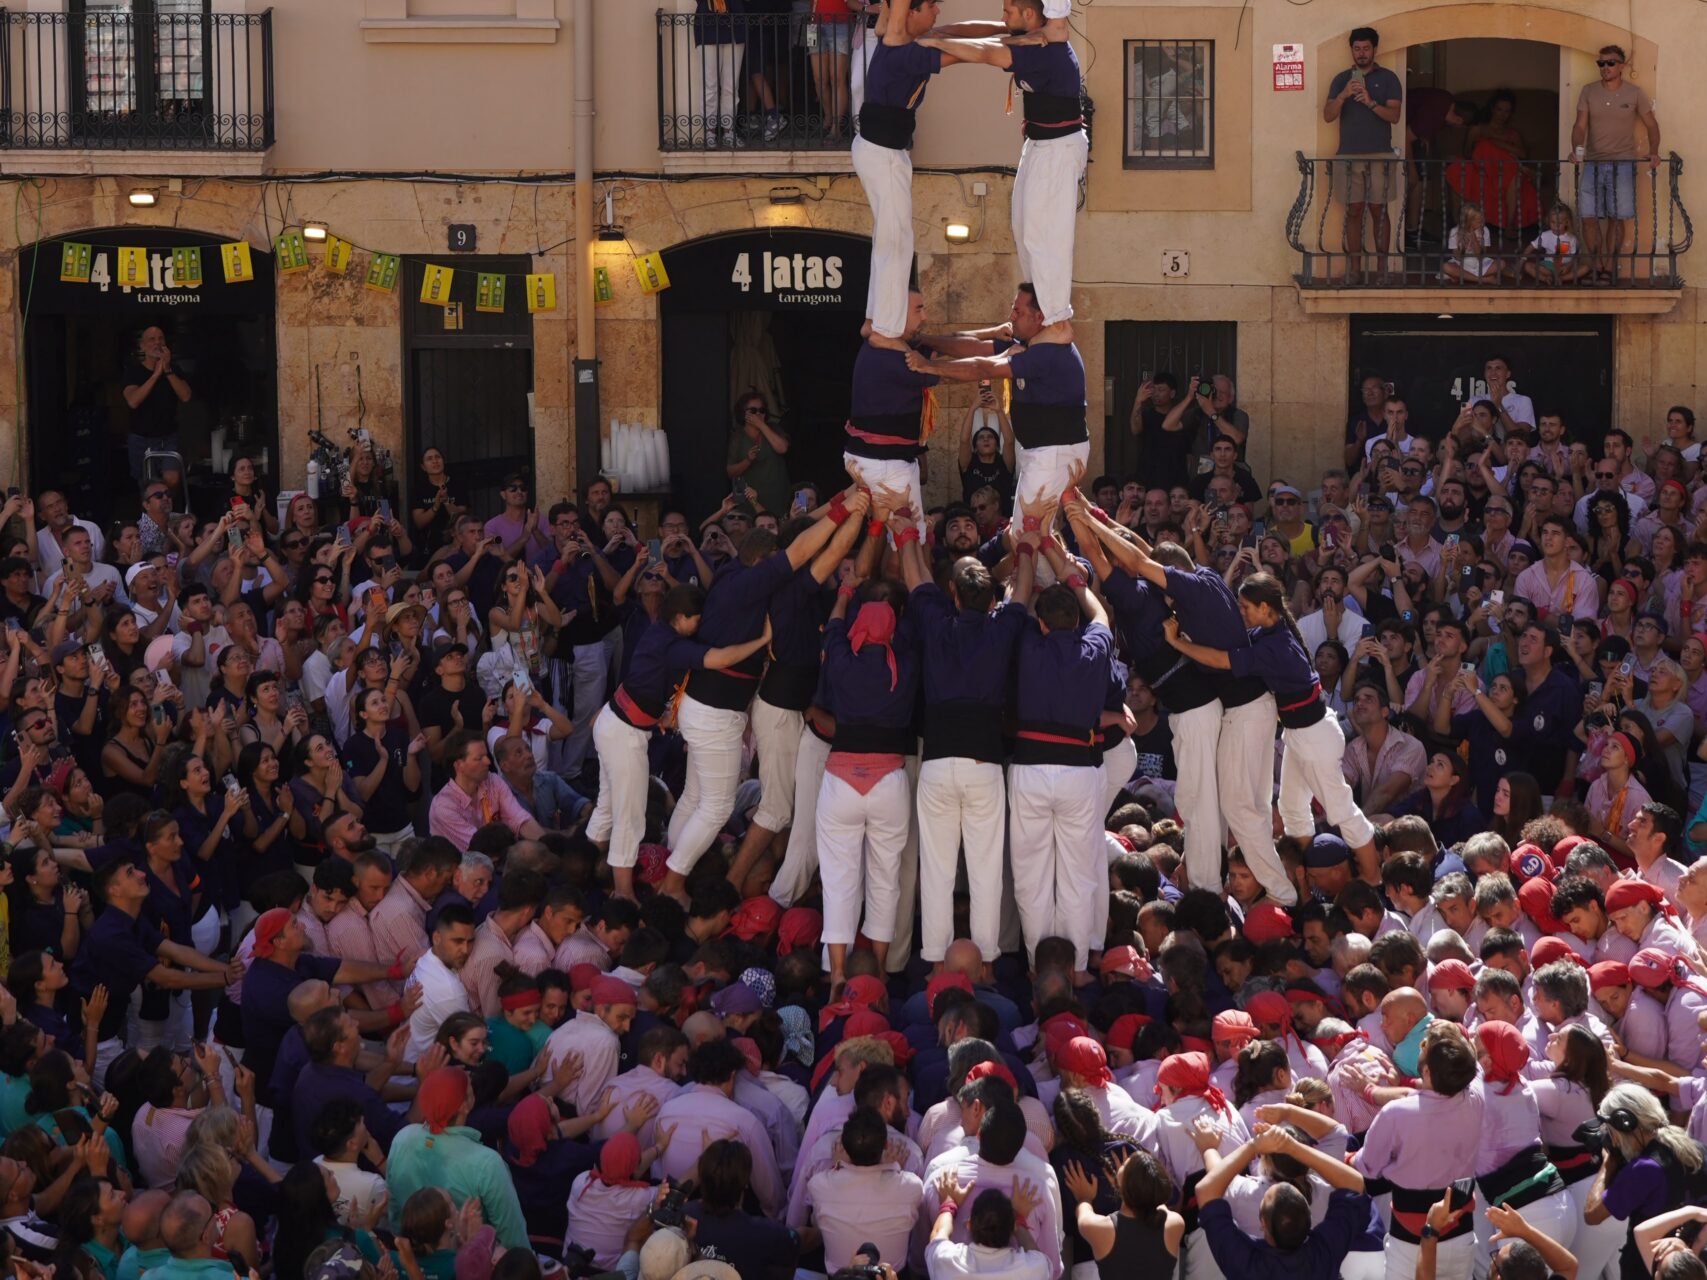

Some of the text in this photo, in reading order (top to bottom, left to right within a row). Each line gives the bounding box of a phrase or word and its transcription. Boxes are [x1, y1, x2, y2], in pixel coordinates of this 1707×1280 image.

[457, 230, 466, 246] 9
[91, 252, 111, 292] 4
[731, 251, 843, 293] 4 latas
[1170, 255, 1180, 272] 5
[137, 292, 201, 305] tarragona
[778, 292, 842, 305] tarragona
[1451, 377, 1463, 400] 4
